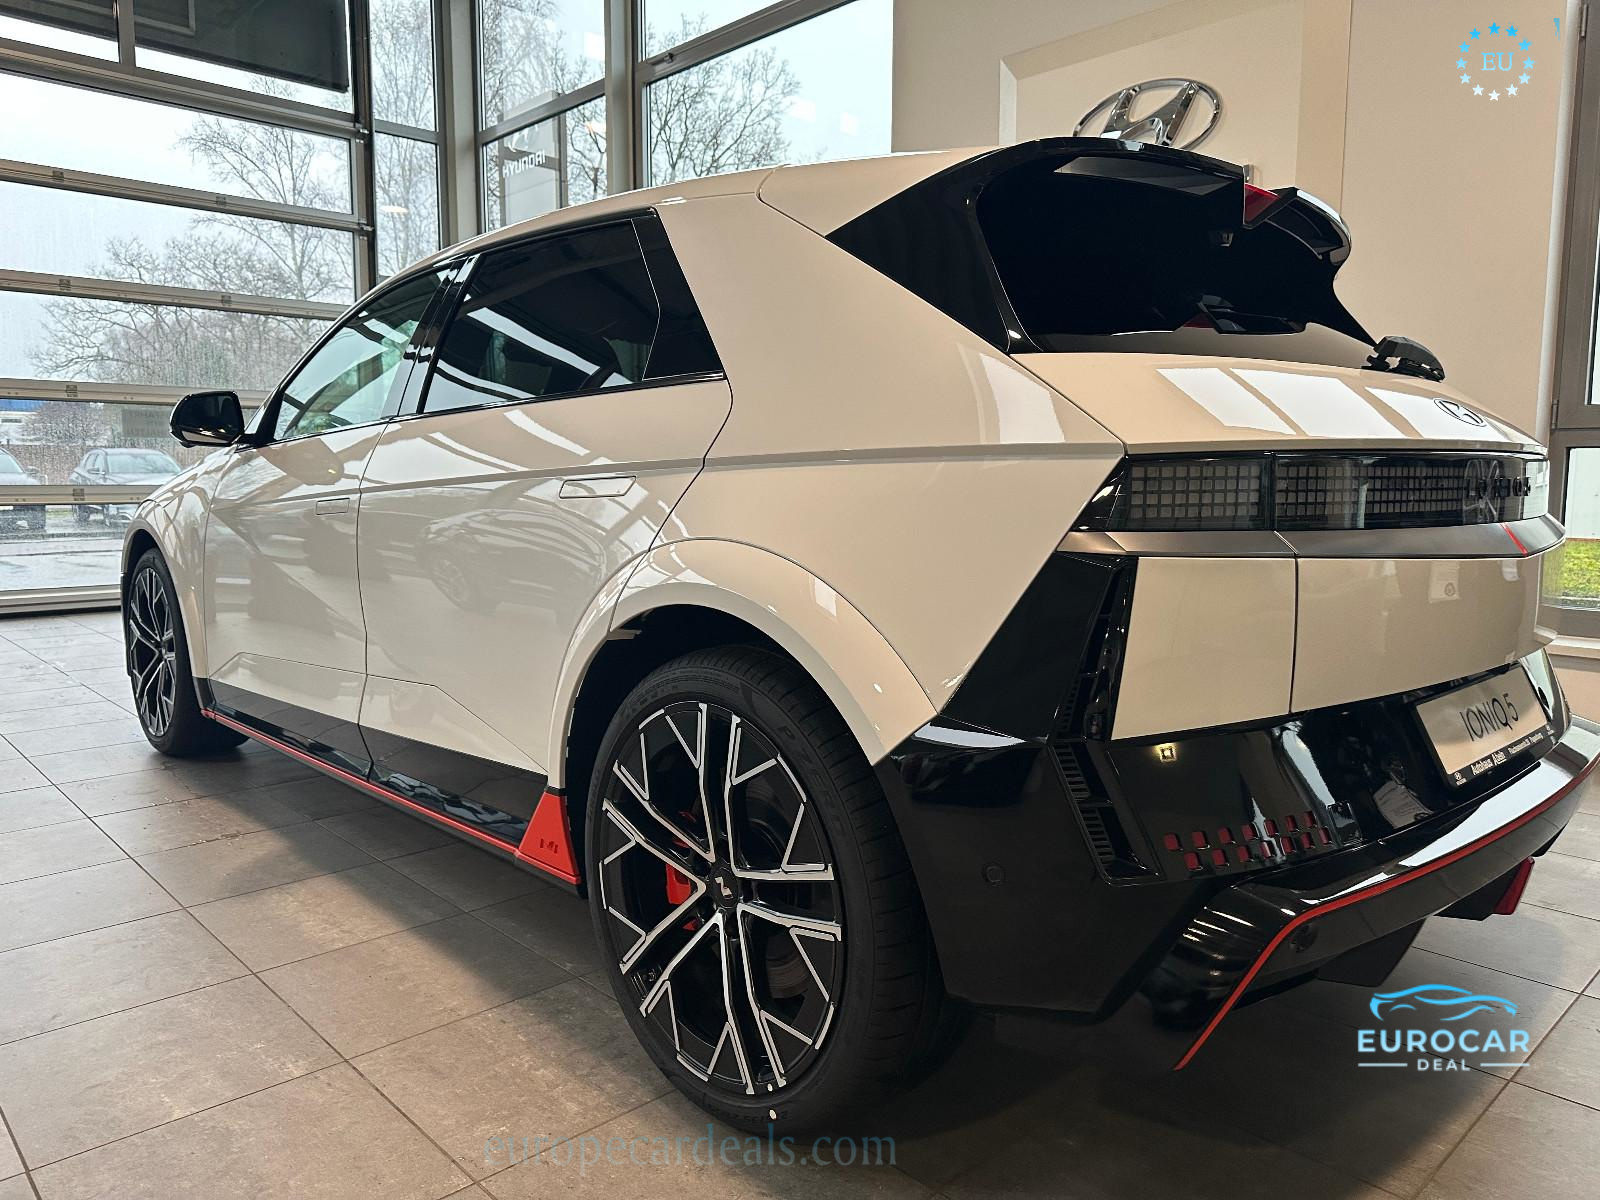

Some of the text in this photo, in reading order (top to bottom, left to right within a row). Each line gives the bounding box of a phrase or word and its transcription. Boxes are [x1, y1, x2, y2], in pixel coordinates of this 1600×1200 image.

[502, 149, 546, 178] HYUNDAI
[1459, 692, 1519, 742] IONIQ 5
